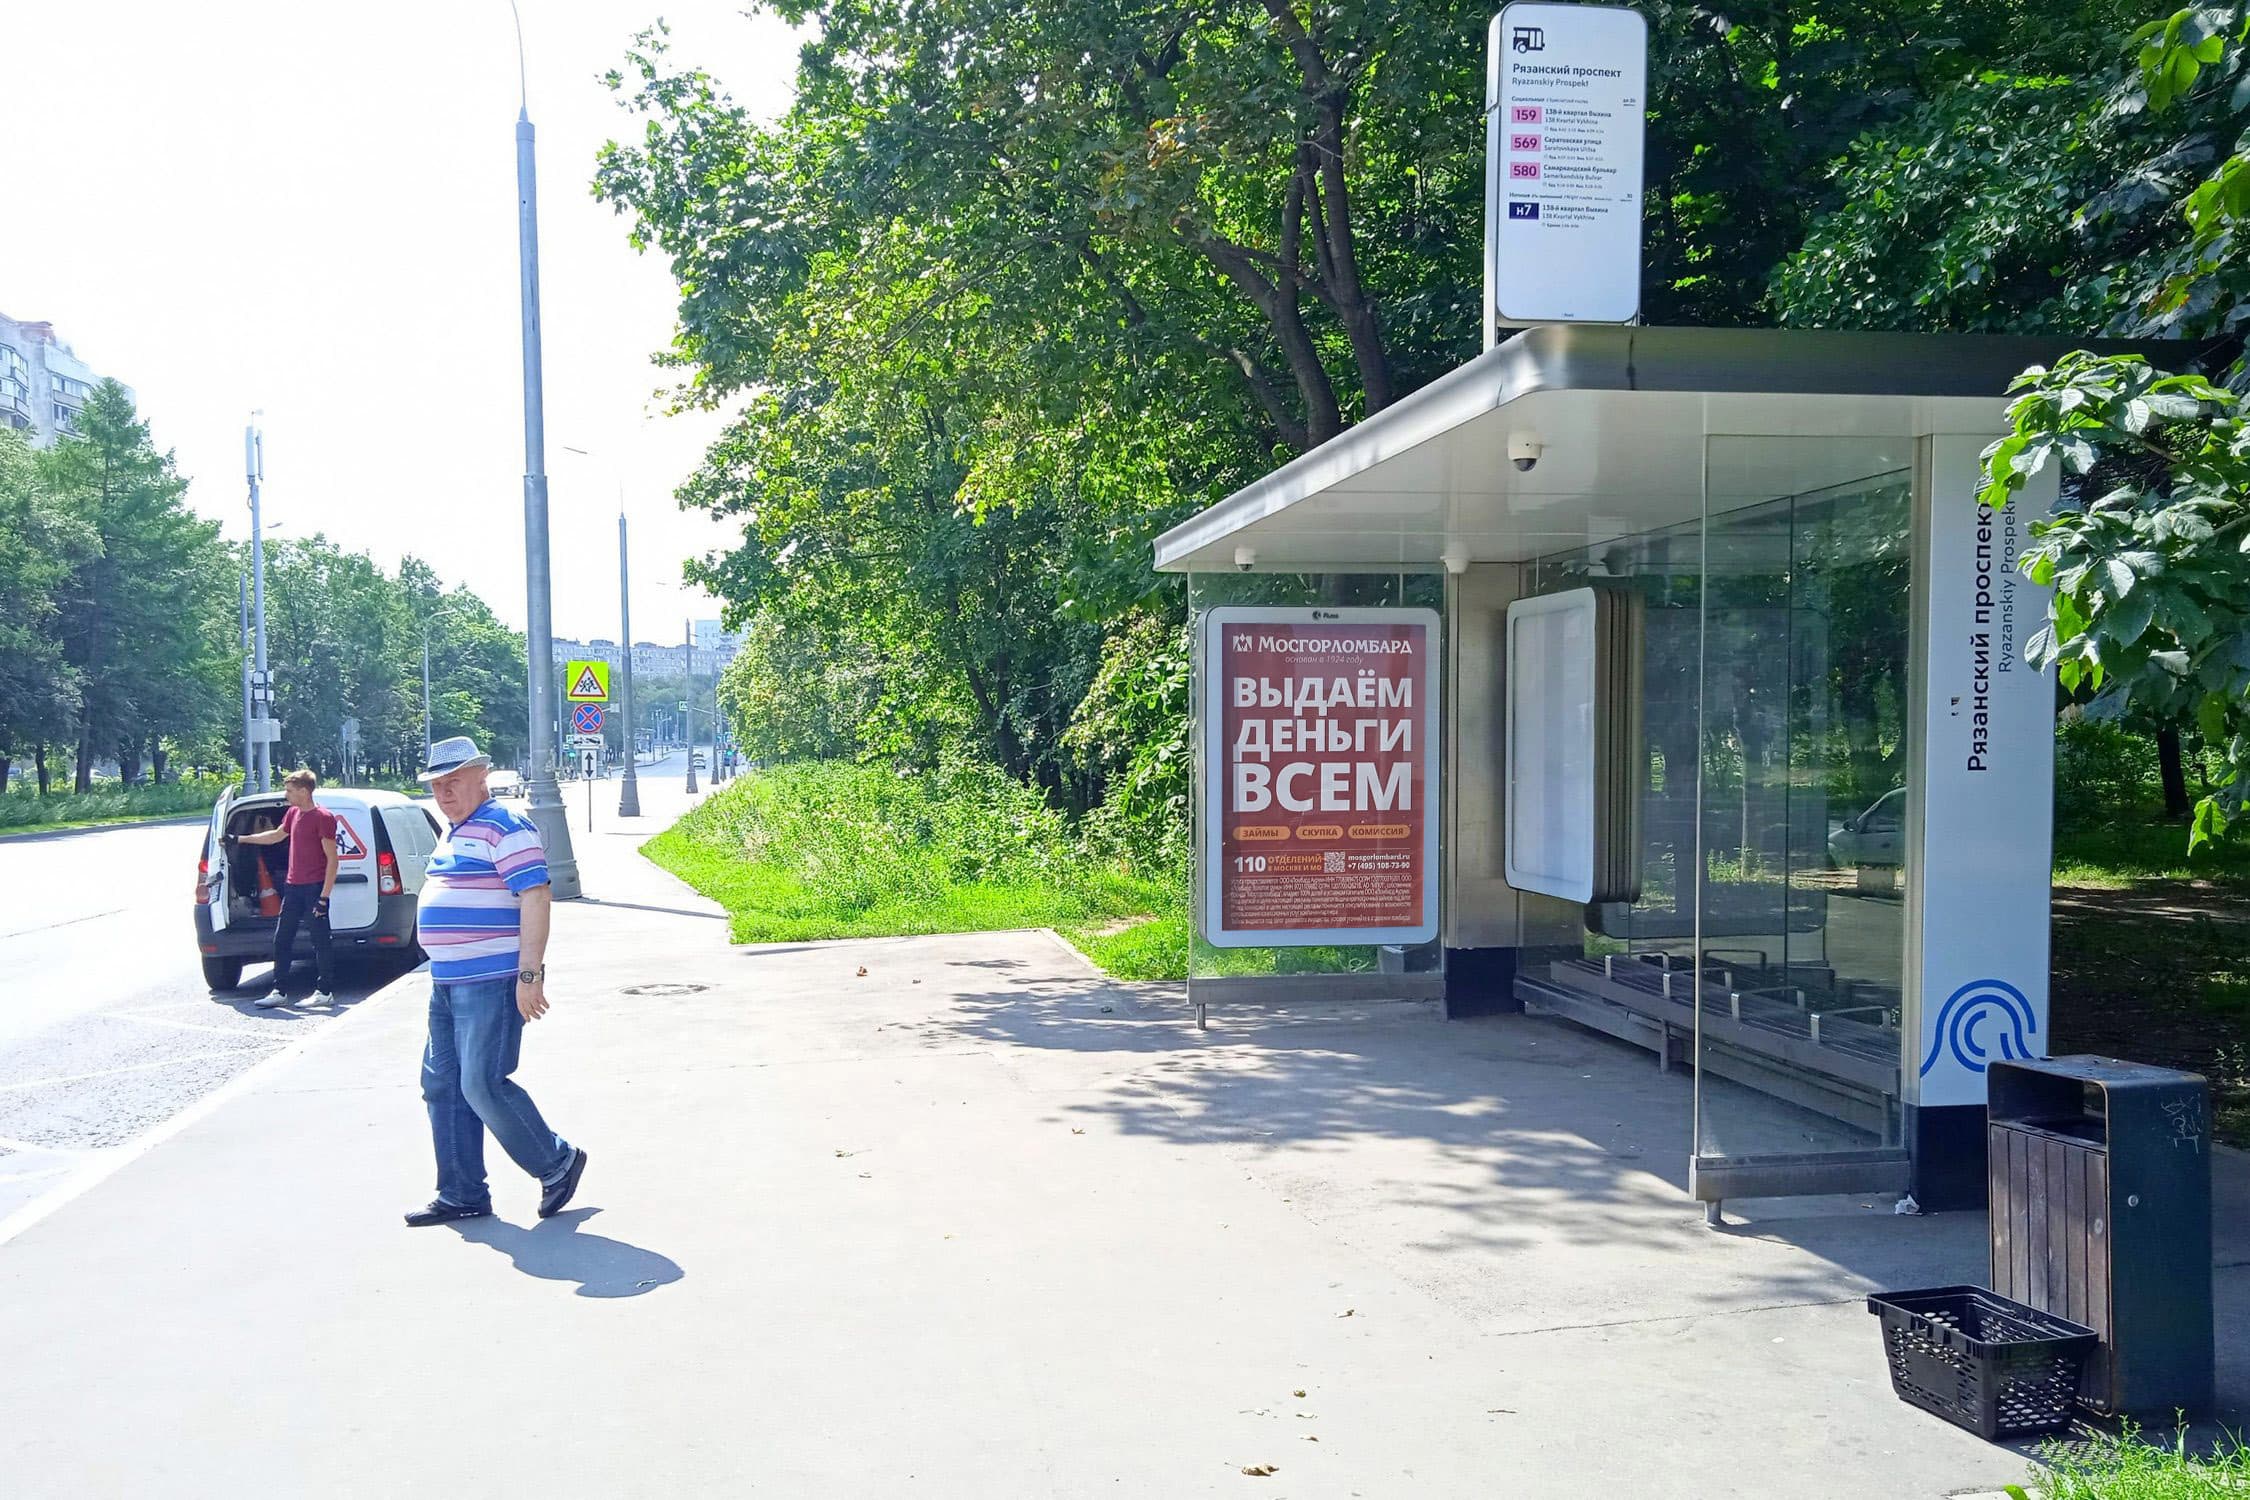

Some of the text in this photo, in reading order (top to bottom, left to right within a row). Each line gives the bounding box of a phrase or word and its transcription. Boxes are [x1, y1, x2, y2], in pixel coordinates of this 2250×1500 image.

[1512, 63, 1621, 78] Рязанский проспект
[1512, 77, 1588, 88] Ryazanskiy Prospekt
[1516, 109, 1537, 121] 159
[1514, 137, 1538, 149] 569
[1513, 165, 1537, 177] 580
[1998, 578, 2017, 673] Ryazanskiy
[1285, 656, 1318, 664] основан
[1326, 656, 1345, 664] 1924
[1346, 656, 1363, 665] году
[1233, 669, 1413, 717] ВЫДАЁМ
[1967, 634, 1990, 771] Рязанский
[1232, 719, 1412, 762] ДЕНЬГИ
[1232, 762, 1412, 813] ВСЕМ
[1242, 826, 1279, 838] ЗАЙМЫ
[1302, 827, 1339, 837] СКУПКА
[1352, 826, 1404, 836] КОМИССИЯ
[1267, 853, 1322, 865] ОТДЕЛЕНИЙ
[1348, 852, 1411, 862] mosgorlombard.ru
[1234, 856, 1266, 873] 110
